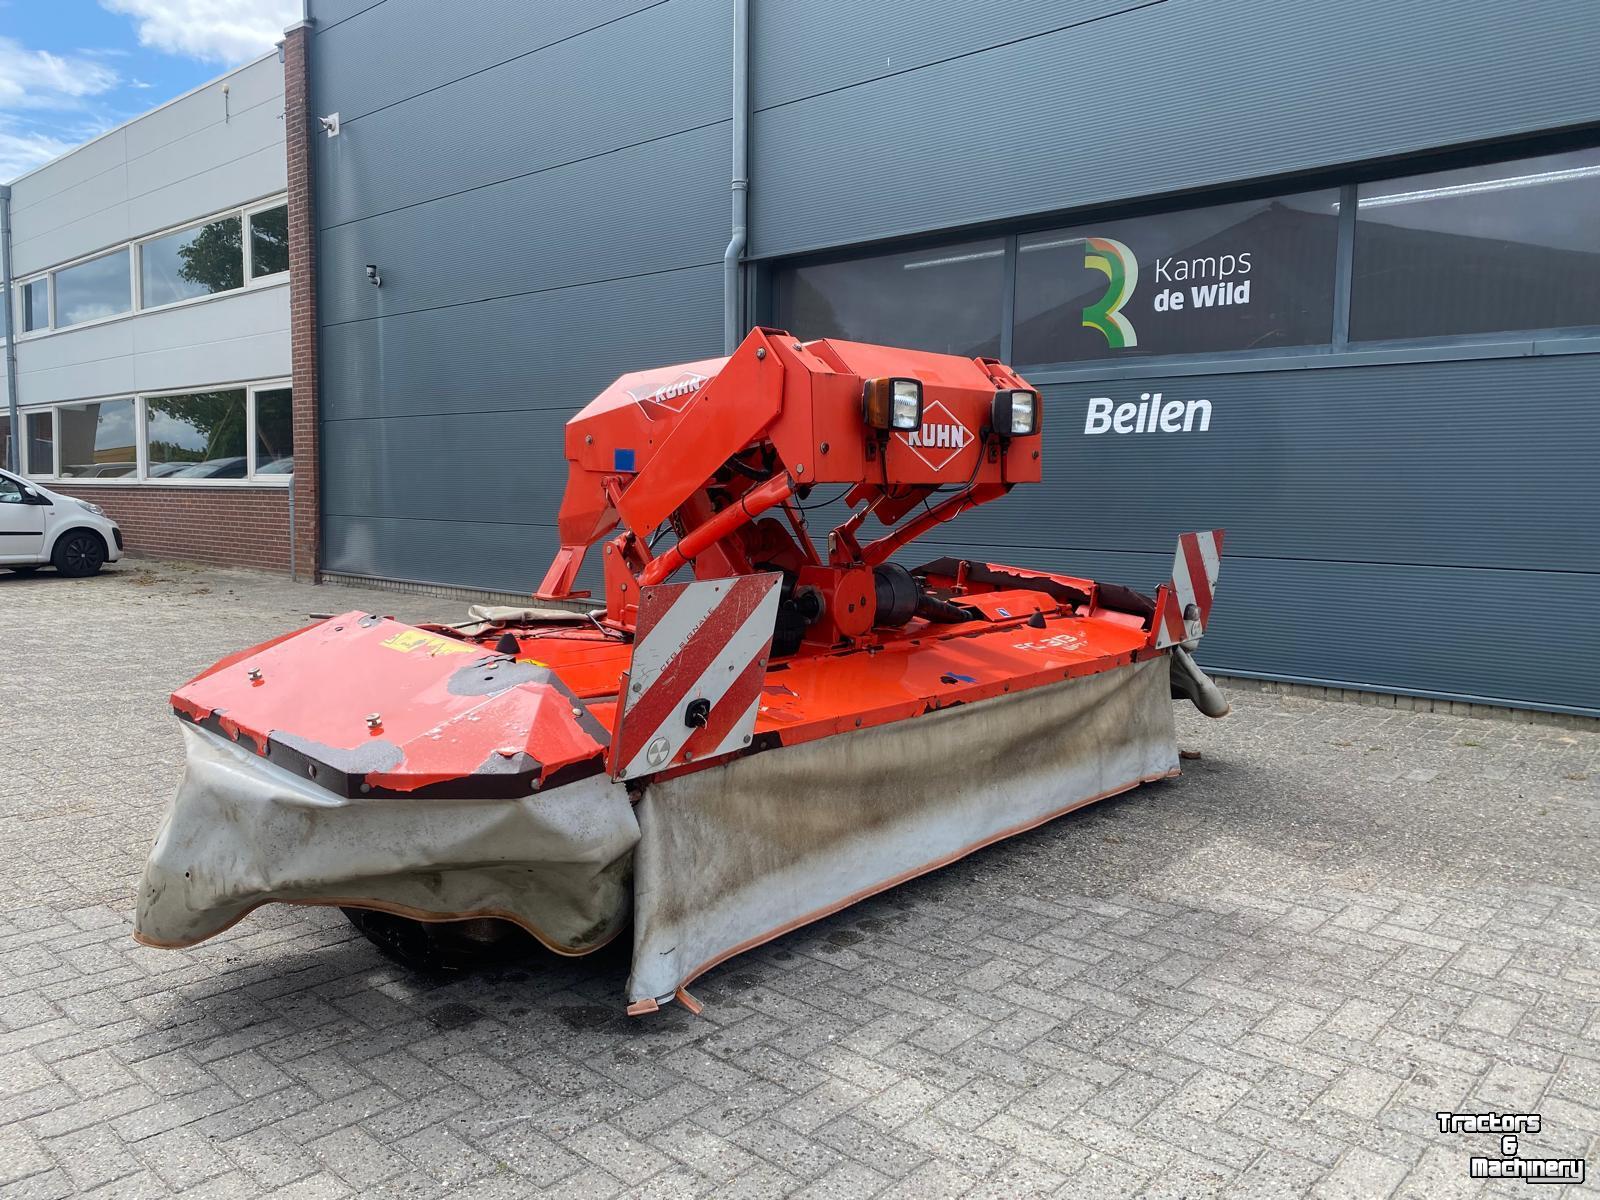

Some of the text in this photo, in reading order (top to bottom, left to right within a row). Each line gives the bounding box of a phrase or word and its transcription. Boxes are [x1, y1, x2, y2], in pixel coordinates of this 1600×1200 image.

[1154, 252, 1252, 283] Kamps
[1153, 280, 1251, 312] de Wild
[655, 376, 701, 403] KUHN
[1084, 392, 1213, 434] Beilen
[907, 423, 965, 449] KUHN
